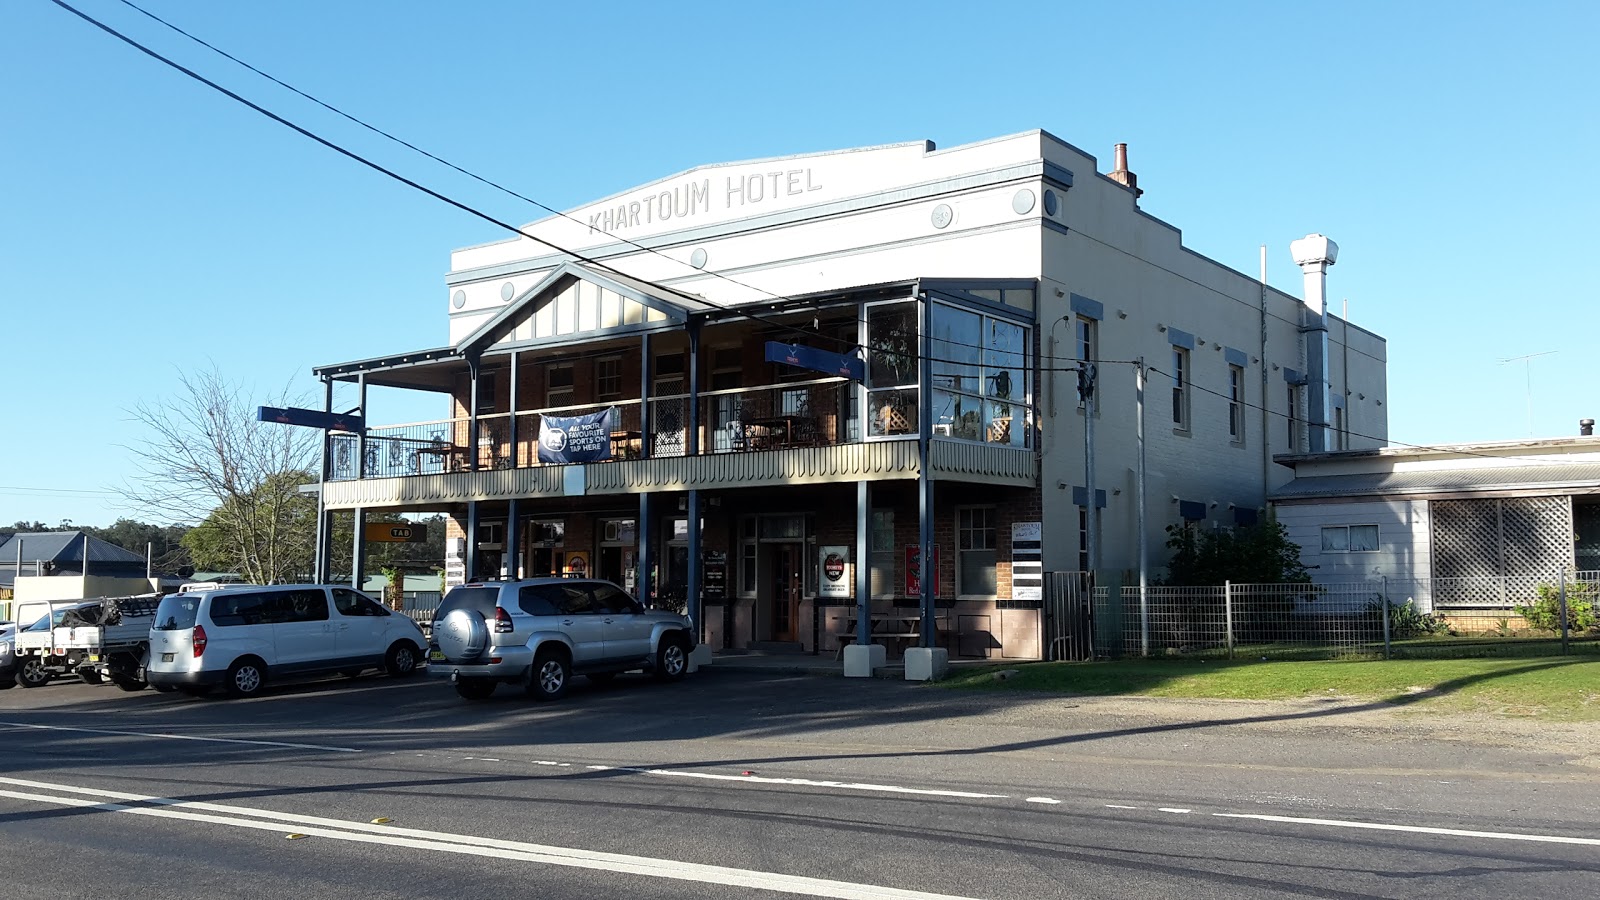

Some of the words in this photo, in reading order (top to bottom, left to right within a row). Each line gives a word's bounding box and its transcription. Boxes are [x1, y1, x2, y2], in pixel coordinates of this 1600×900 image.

[588, 178, 710, 235] KHARTOUM
[726, 168, 823, 209] HOTEL
[582, 423, 600, 431] YOUR
[568, 429, 604, 438] FAVOURITE
[569, 437, 593, 445] SPORTS
[583, 443, 601, 451] HERE
